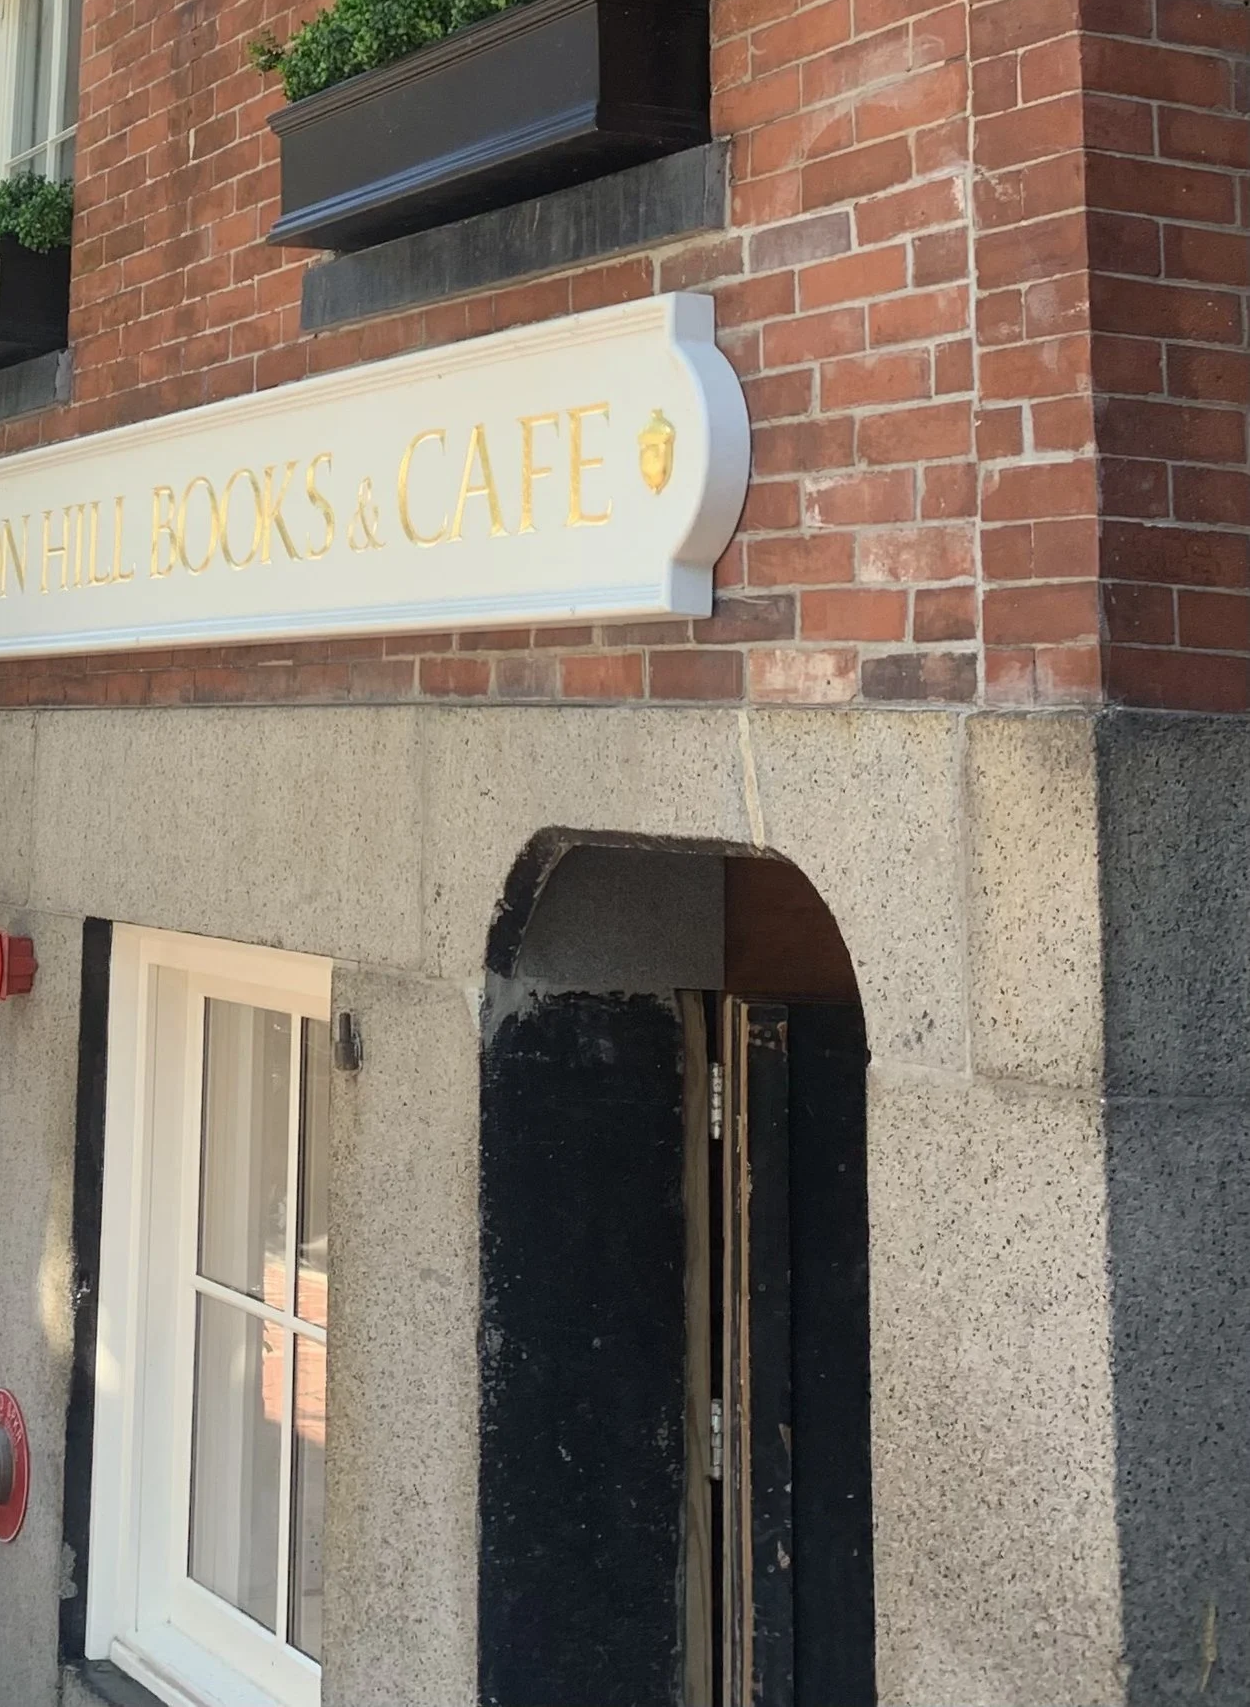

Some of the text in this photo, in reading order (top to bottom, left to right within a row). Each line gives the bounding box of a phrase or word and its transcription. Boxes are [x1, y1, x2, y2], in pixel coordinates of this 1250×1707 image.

[41, 495, 136, 595] HILL
[150, 451, 337, 580] BOOKS
[347, 475, 386, 553] &
[397, 401, 614, 549] CAFE
